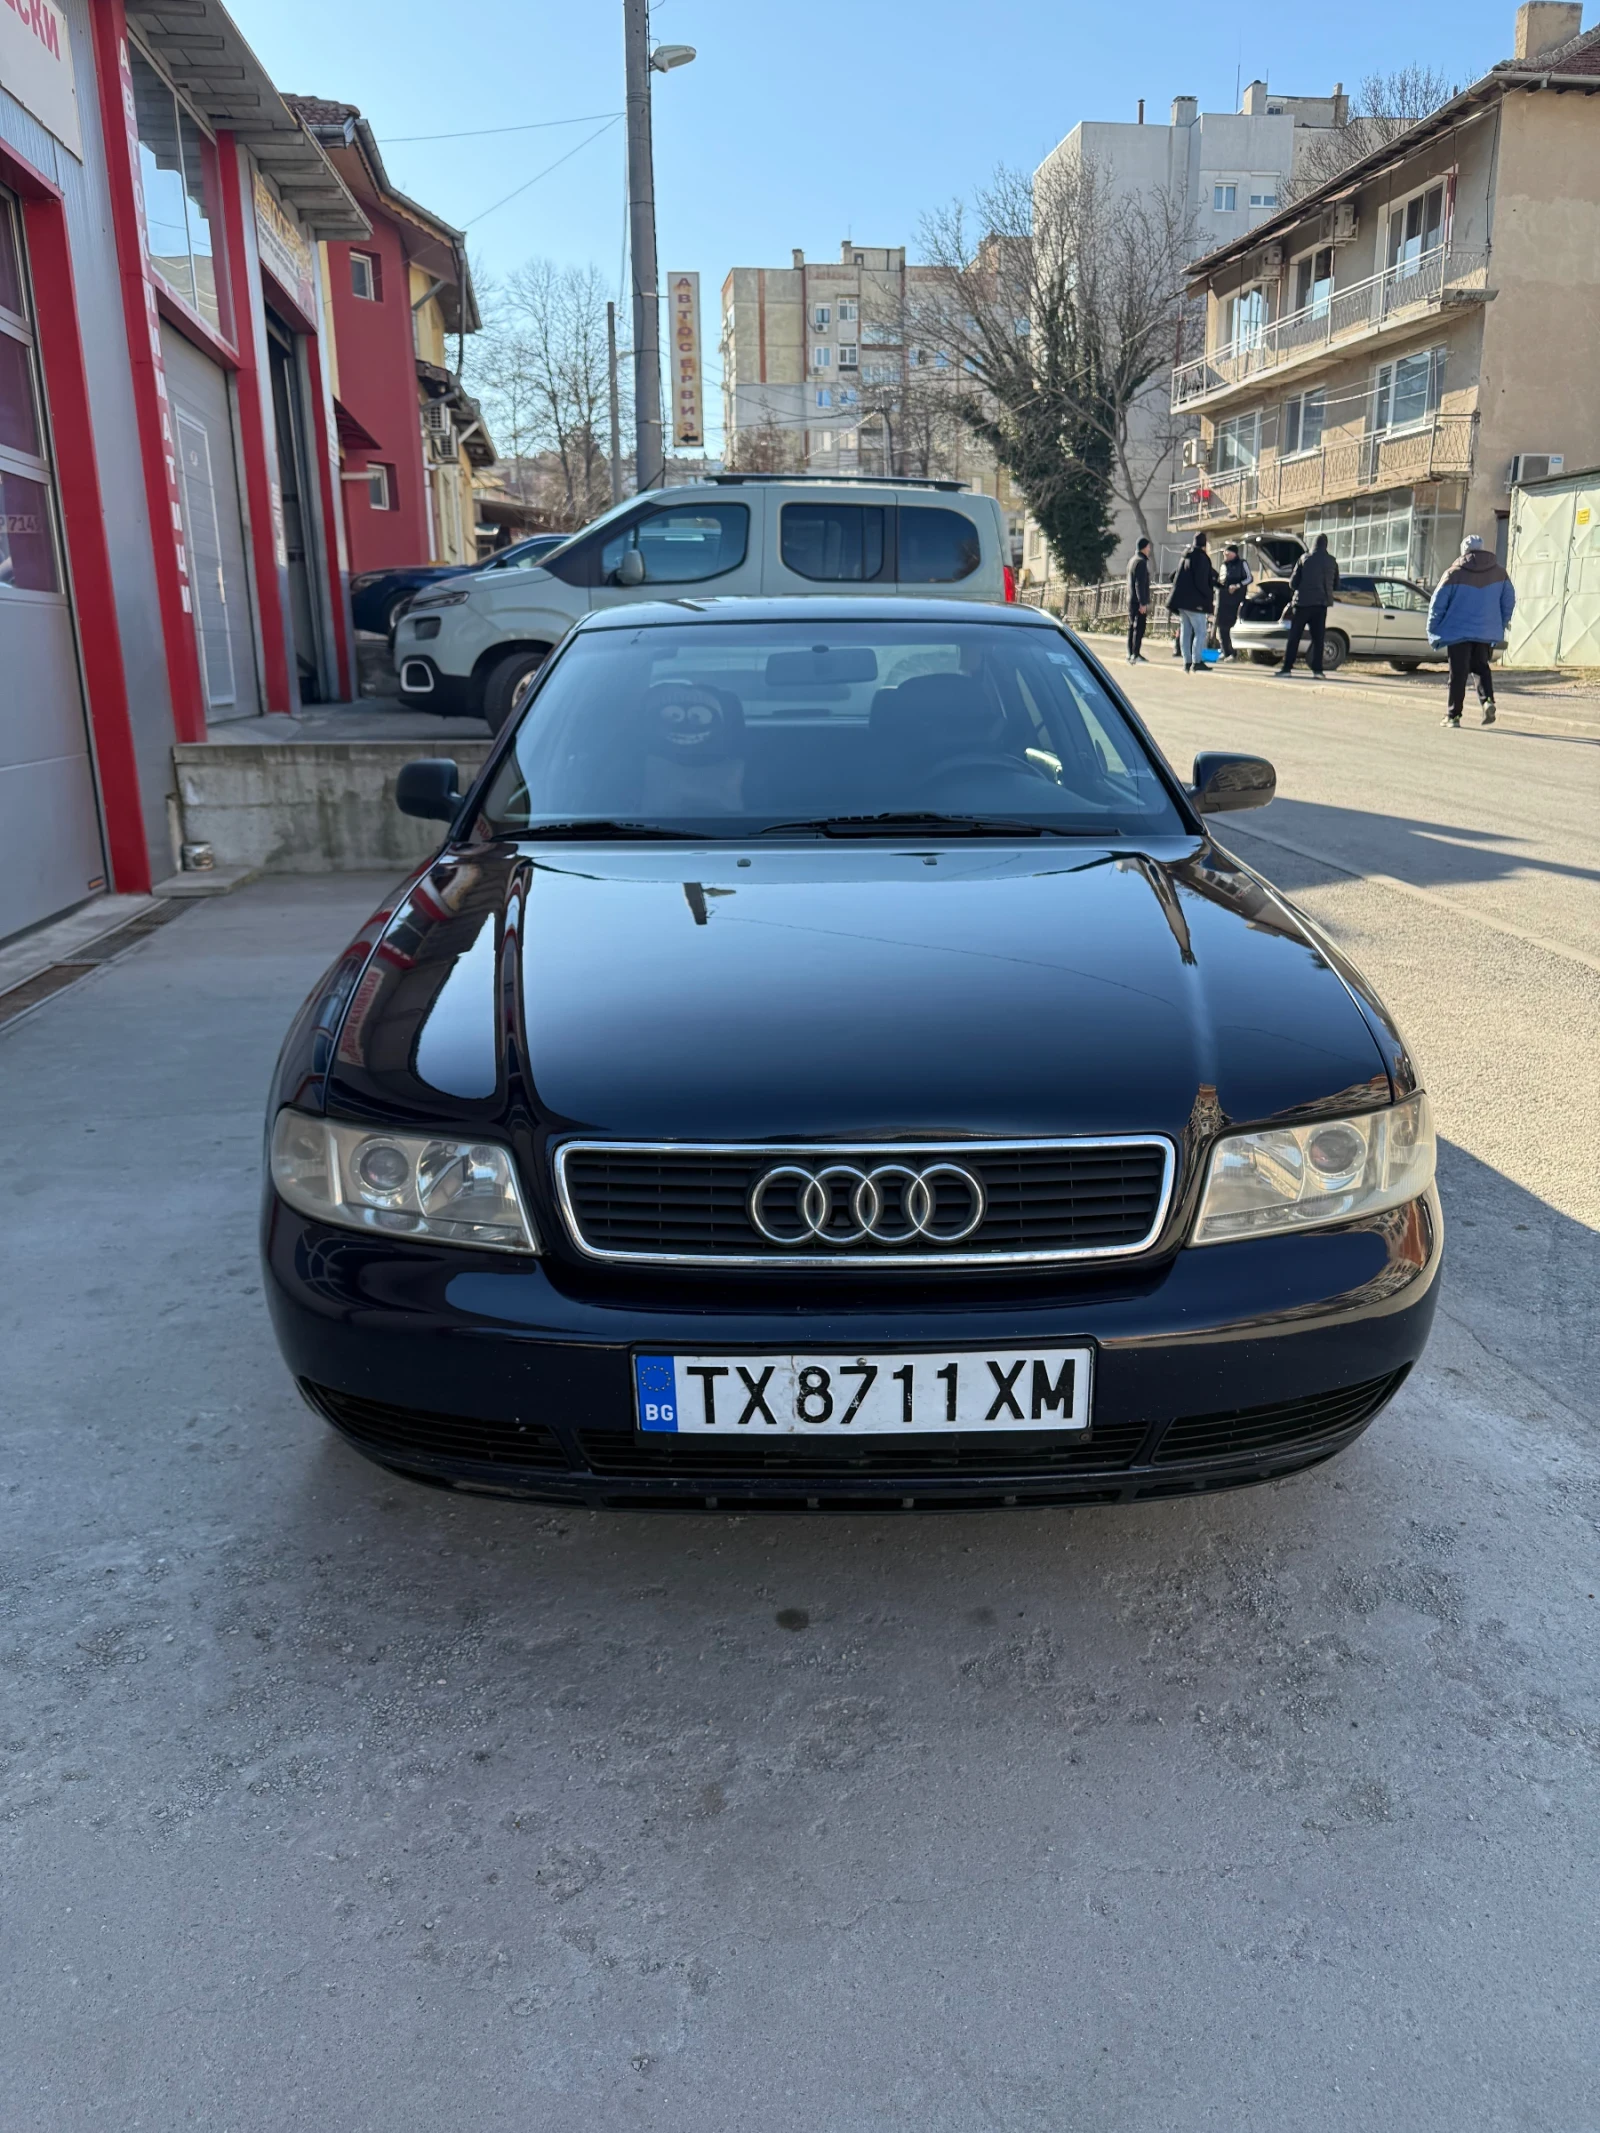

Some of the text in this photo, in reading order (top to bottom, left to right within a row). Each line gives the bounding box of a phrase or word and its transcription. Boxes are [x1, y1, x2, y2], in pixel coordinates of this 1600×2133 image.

[677, 277, 695, 432] АВТОСЕРВИЗ
[645, 1403, 674, 1421] BG
[686, 1358, 1075, 1425] TX 8711 XM
